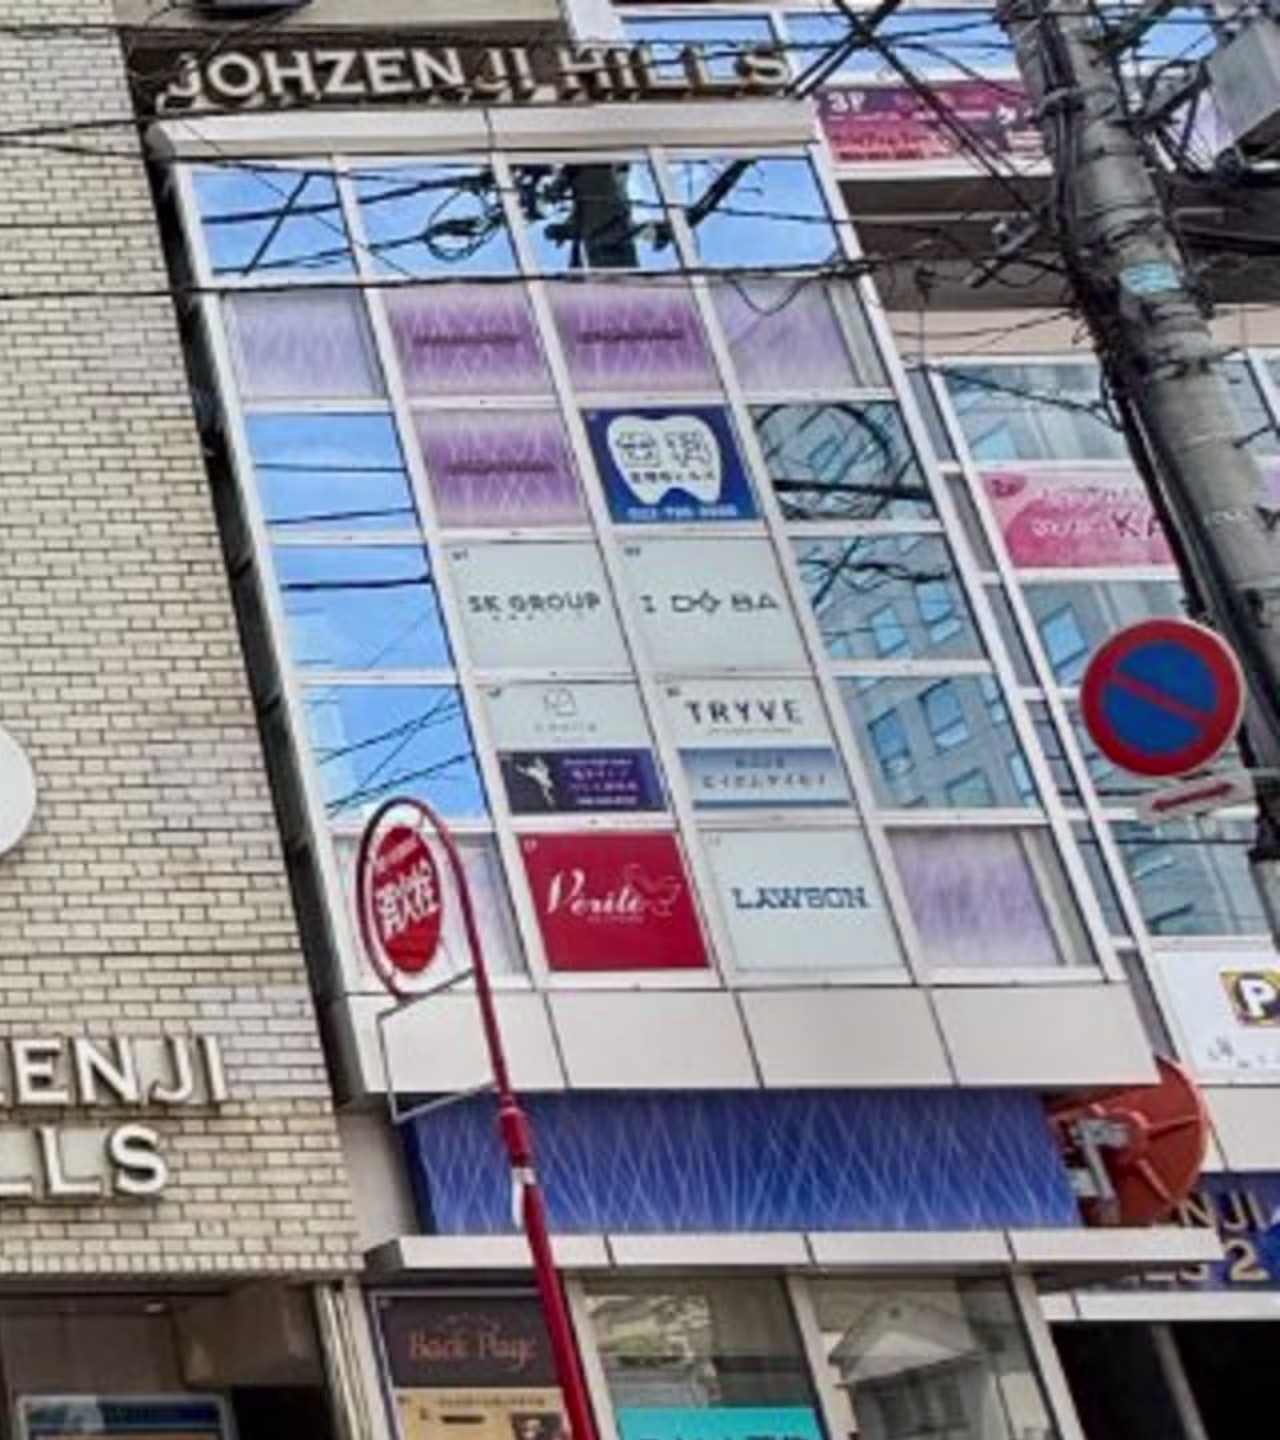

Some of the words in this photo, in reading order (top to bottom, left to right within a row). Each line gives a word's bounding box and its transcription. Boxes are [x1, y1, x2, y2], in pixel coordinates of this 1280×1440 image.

[169, 49, 534, 97] JOHZENJI
[560, 48, 791, 92] HILLS
[508, 591, 601, 613] GROUP
[684, 698, 803, 726] TRYVE
[731, 886, 871, 911] LAWSON
